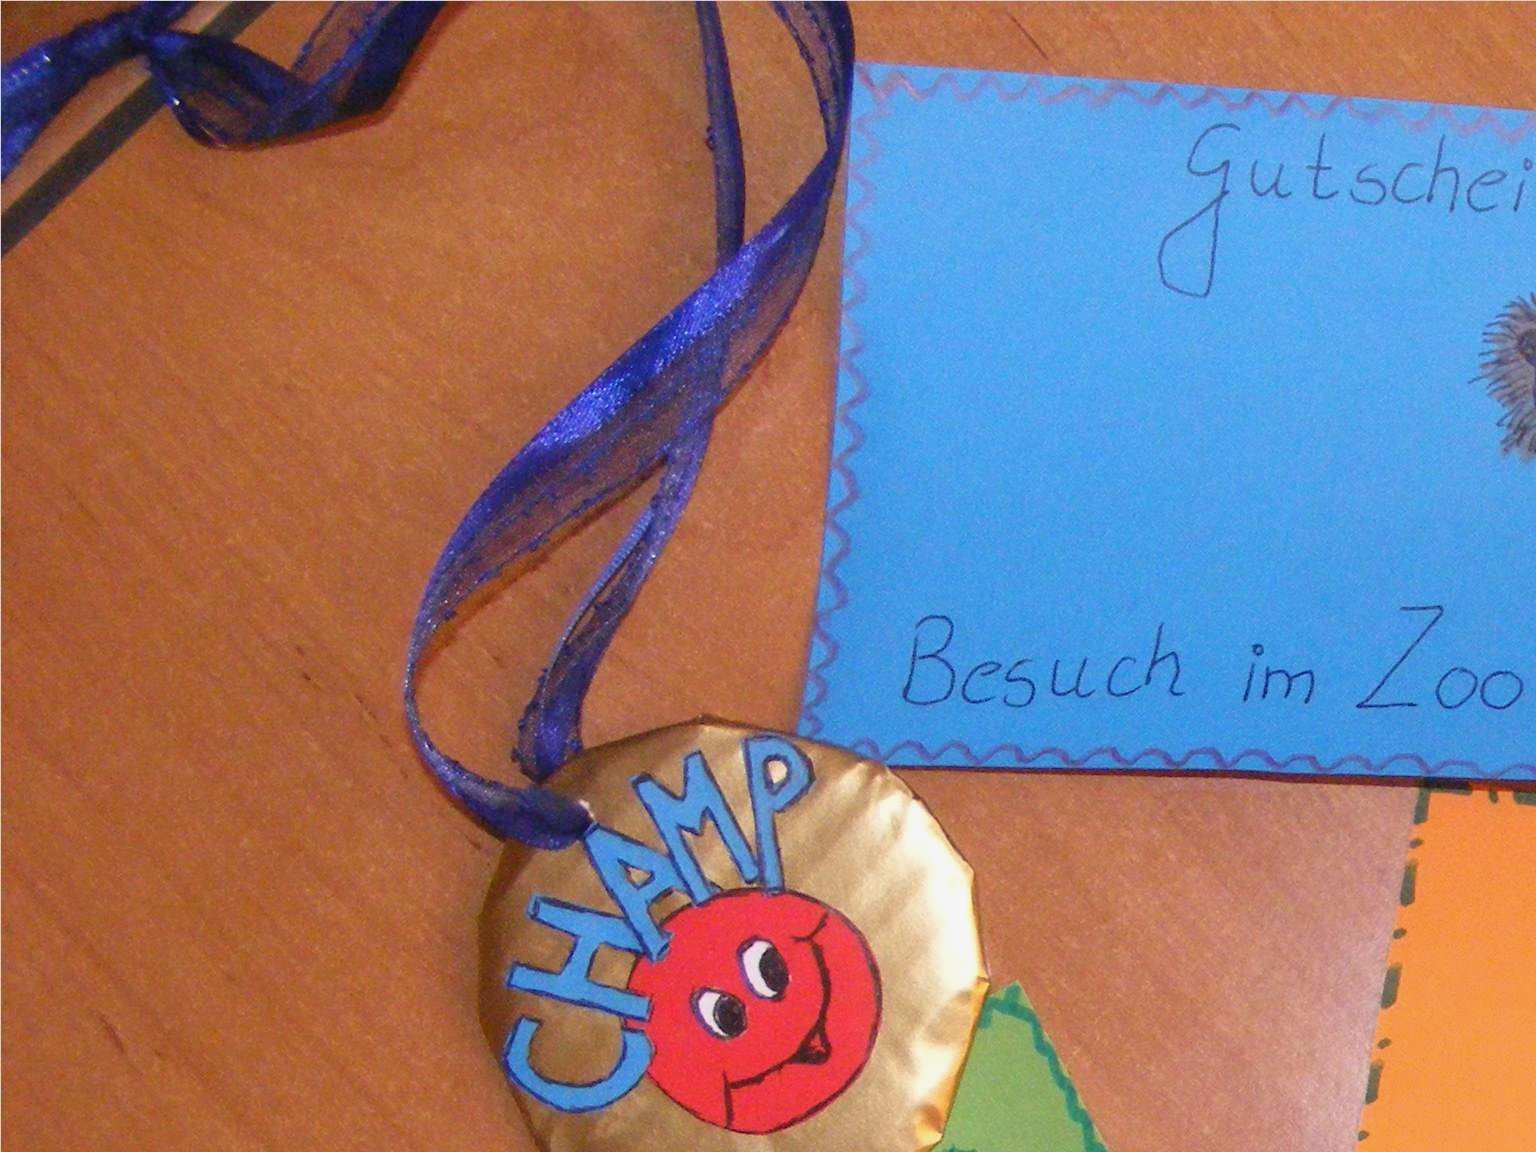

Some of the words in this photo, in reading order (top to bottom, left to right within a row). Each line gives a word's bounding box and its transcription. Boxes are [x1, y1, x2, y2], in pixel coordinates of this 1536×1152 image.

[900, 613, 1186, 707] Besuch
[1240, 642, 1317, 706] im
[1355, 604, 1525, 712] Zoo
[503, 733, 816, 1114] CHAMP
